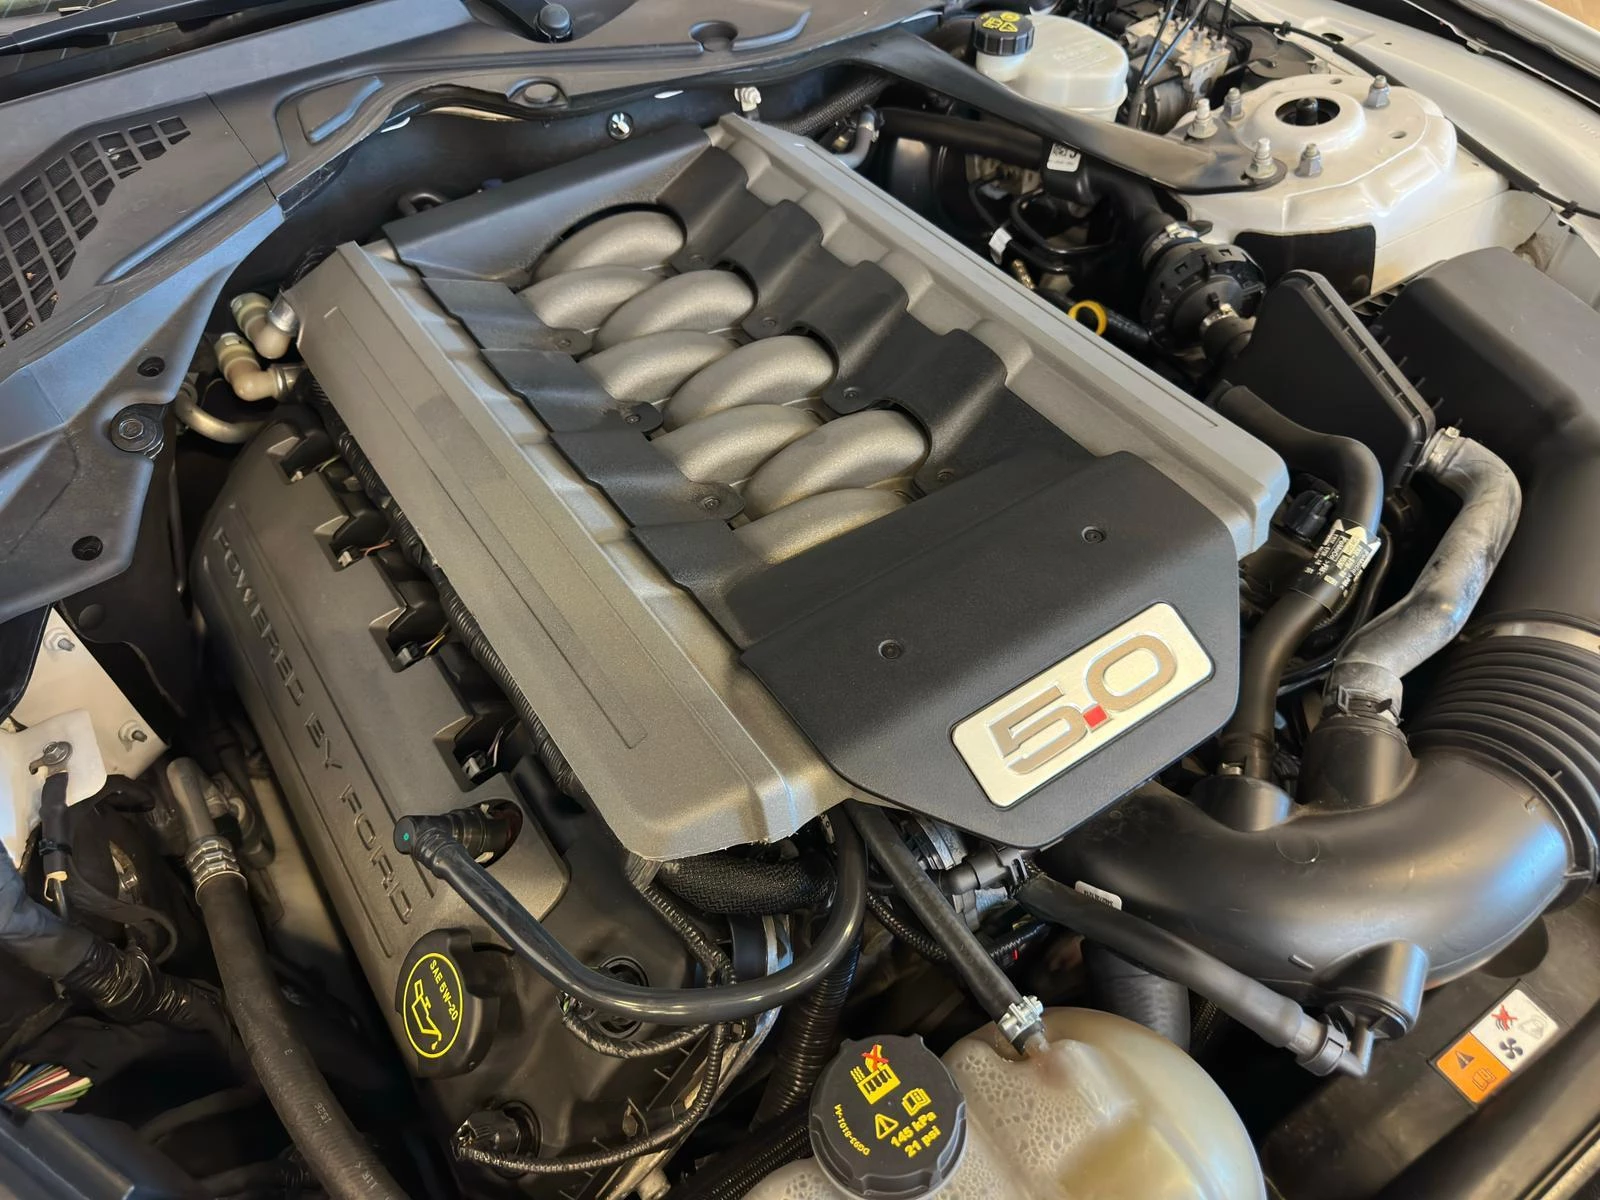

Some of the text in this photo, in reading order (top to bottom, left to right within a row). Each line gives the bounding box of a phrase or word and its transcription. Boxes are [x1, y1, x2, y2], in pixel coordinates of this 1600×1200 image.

[213, 527, 414, 925] POWERED BY FORD
[987, 631, 1178, 775] 5.0
[429, 959, 460, 1021] SAE 5W-20
[890, 1111, 938, 1148] 145 kPa
[904, 1125, 942, 1159] 21 psi
